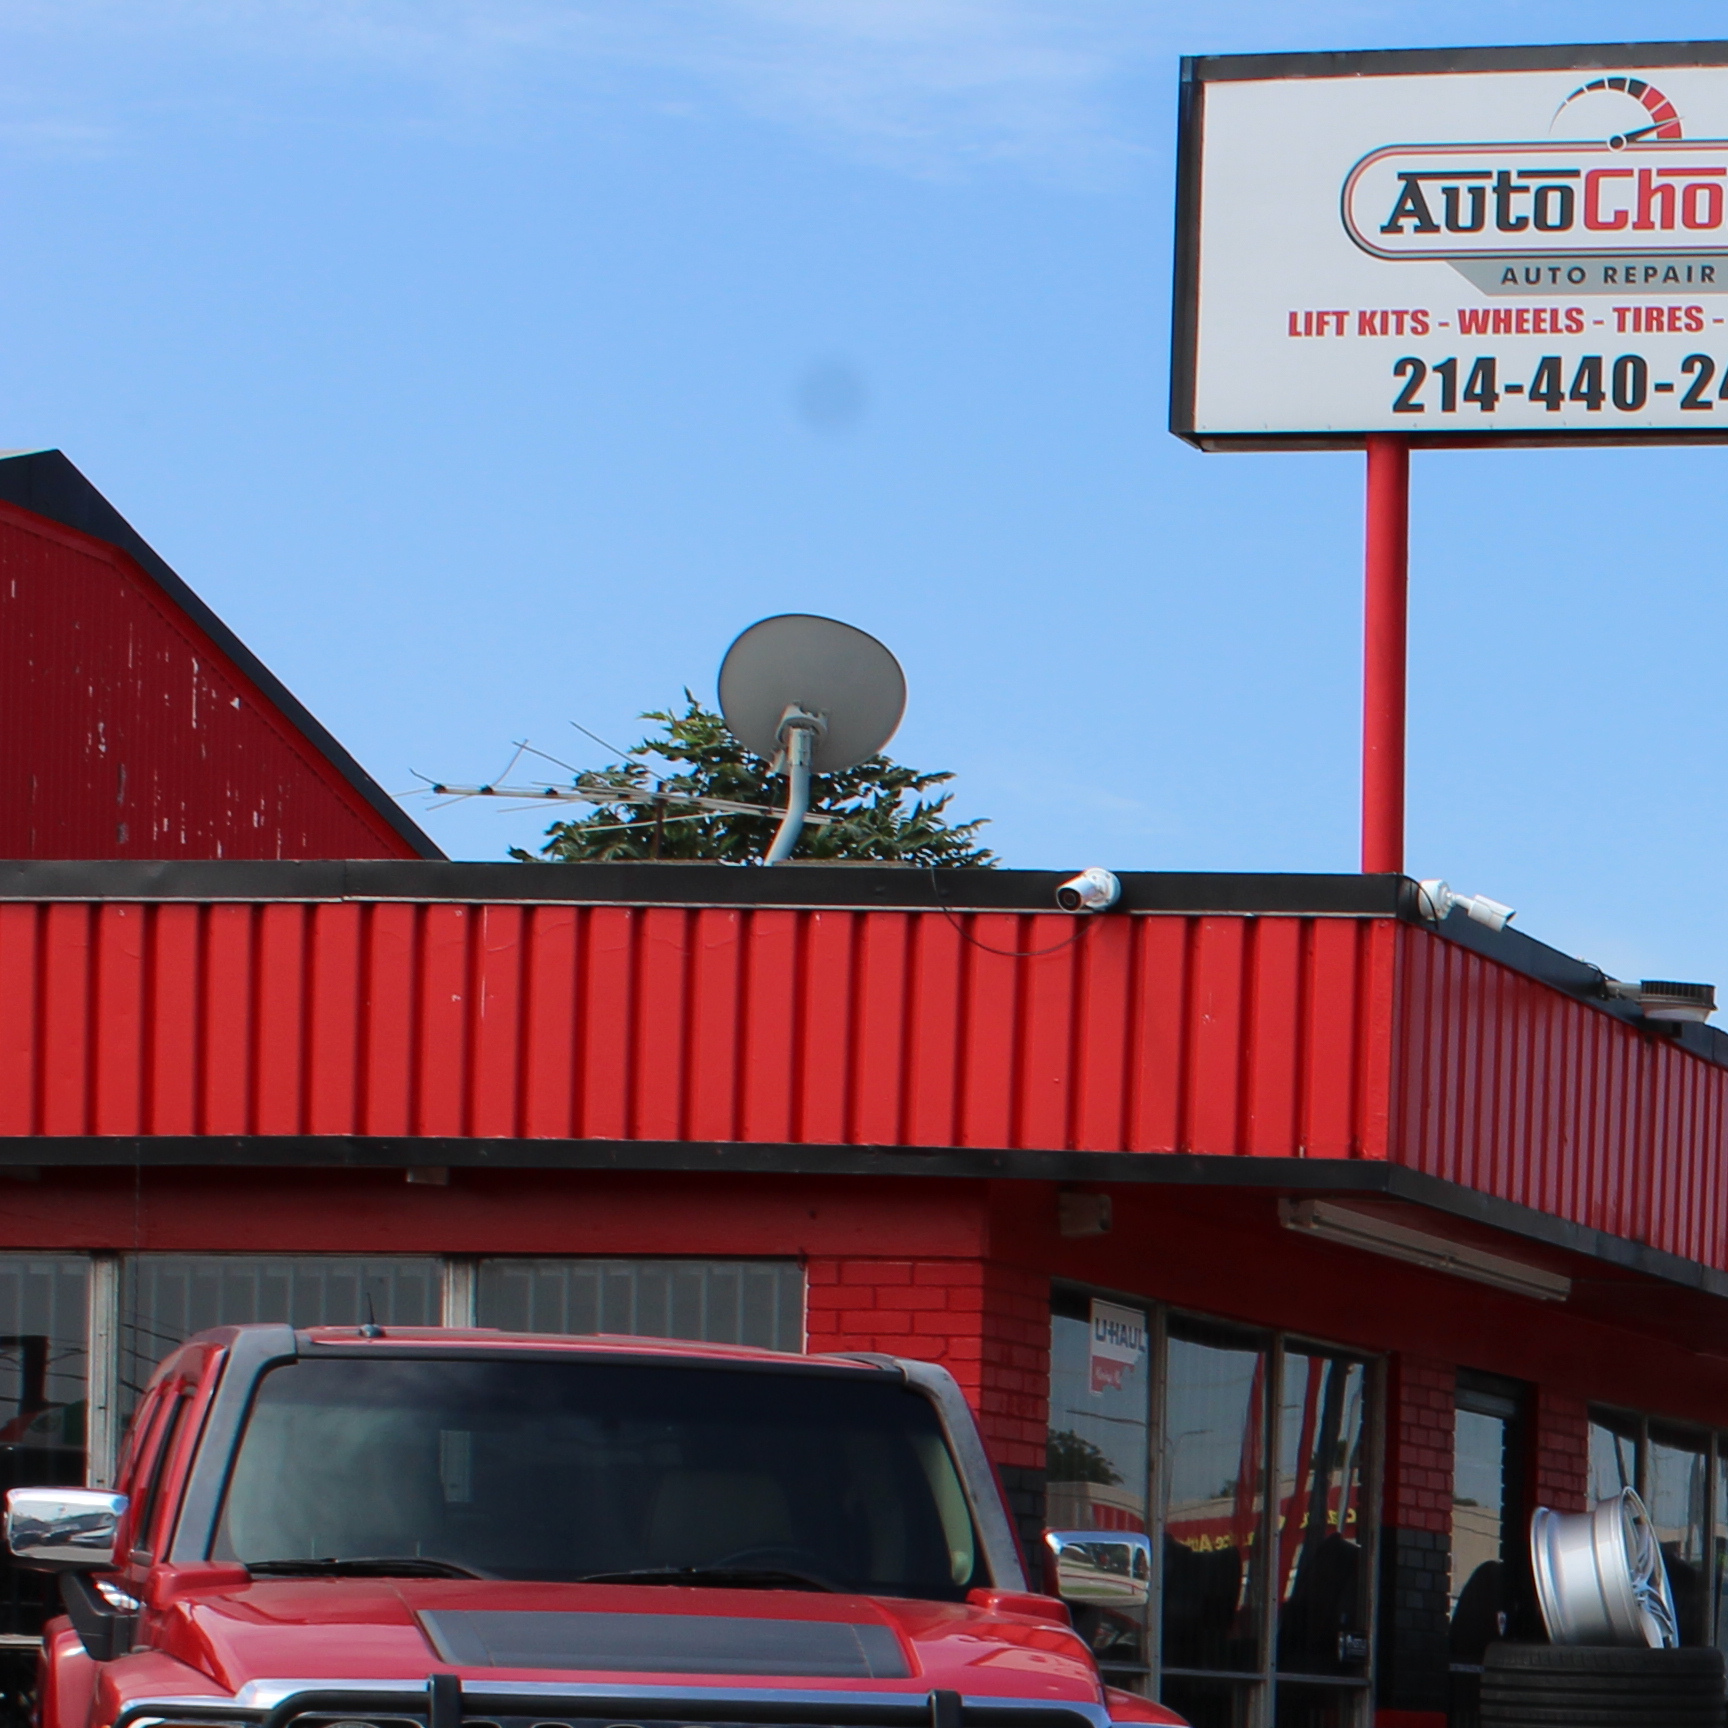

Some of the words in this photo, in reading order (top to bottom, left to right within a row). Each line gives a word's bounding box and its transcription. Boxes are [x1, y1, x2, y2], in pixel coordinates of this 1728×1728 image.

[1501, 266, 1587, 286] AUTO
[1603, 264, 1716, 285] REPAIR
[1288, 310, 1350, 337] LIFT
[1357, 309, 1431, 336] KITS
[1457, 307, 1585, 335] WHEELS
[1612, 305, 1705, 333] TIRES
